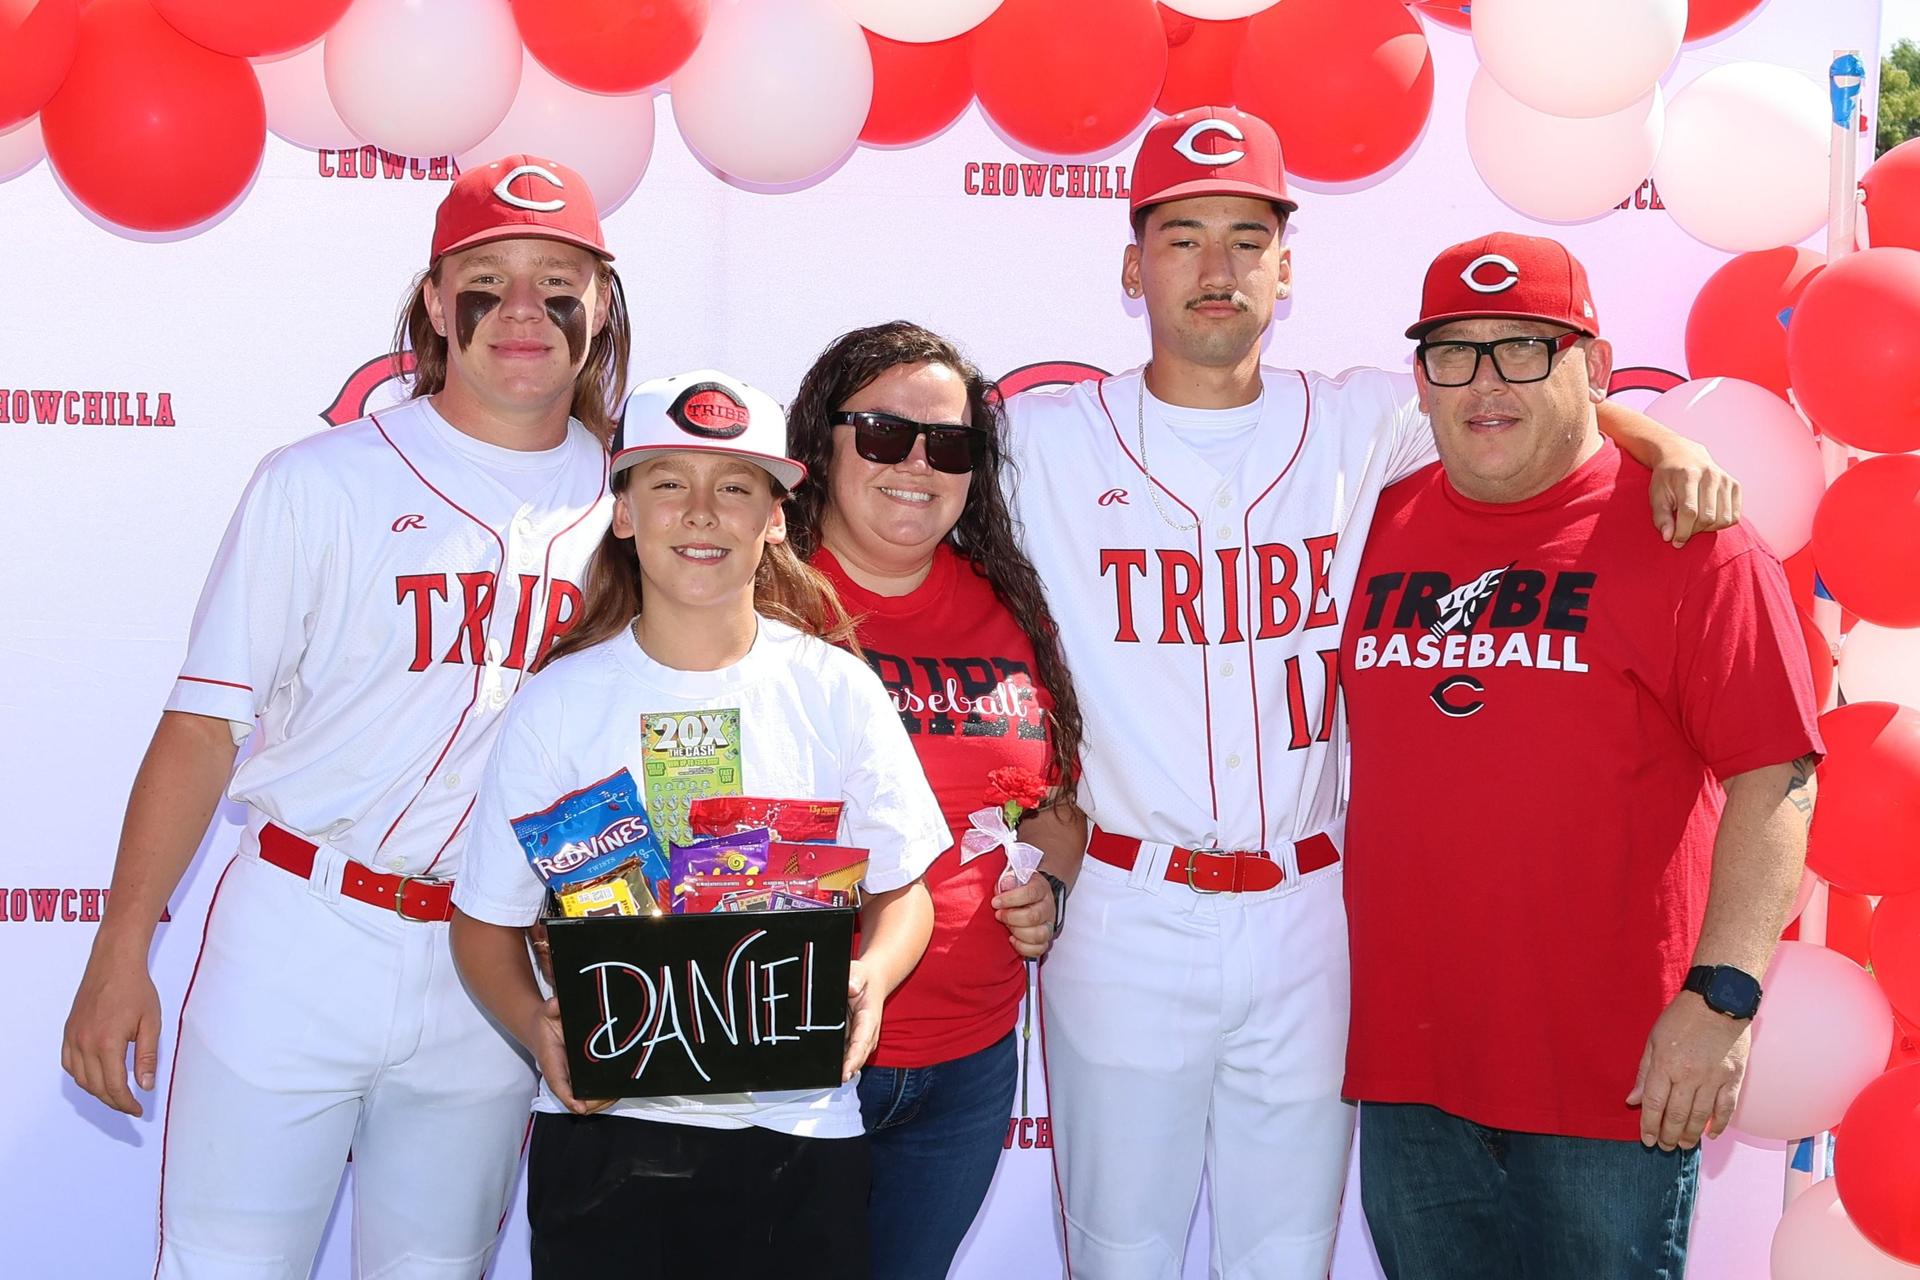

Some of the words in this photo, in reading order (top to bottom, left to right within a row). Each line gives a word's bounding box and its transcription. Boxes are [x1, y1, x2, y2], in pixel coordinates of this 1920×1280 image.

[688, 403, 747, 422] TRIBE
[1100, 533, 1339, 645] TRIBE
[1355, 633, 1589, 673] BASEBALL
[654, 714, 729, 751] 20X
[668, 748, 684, 757] THE
[685, 745, 715, 757] CASH
[579, 816, 649, 860] VINES
[587, 857, 616, 873] TWISTS
[578, 928, 846, 1083] DANIEL
